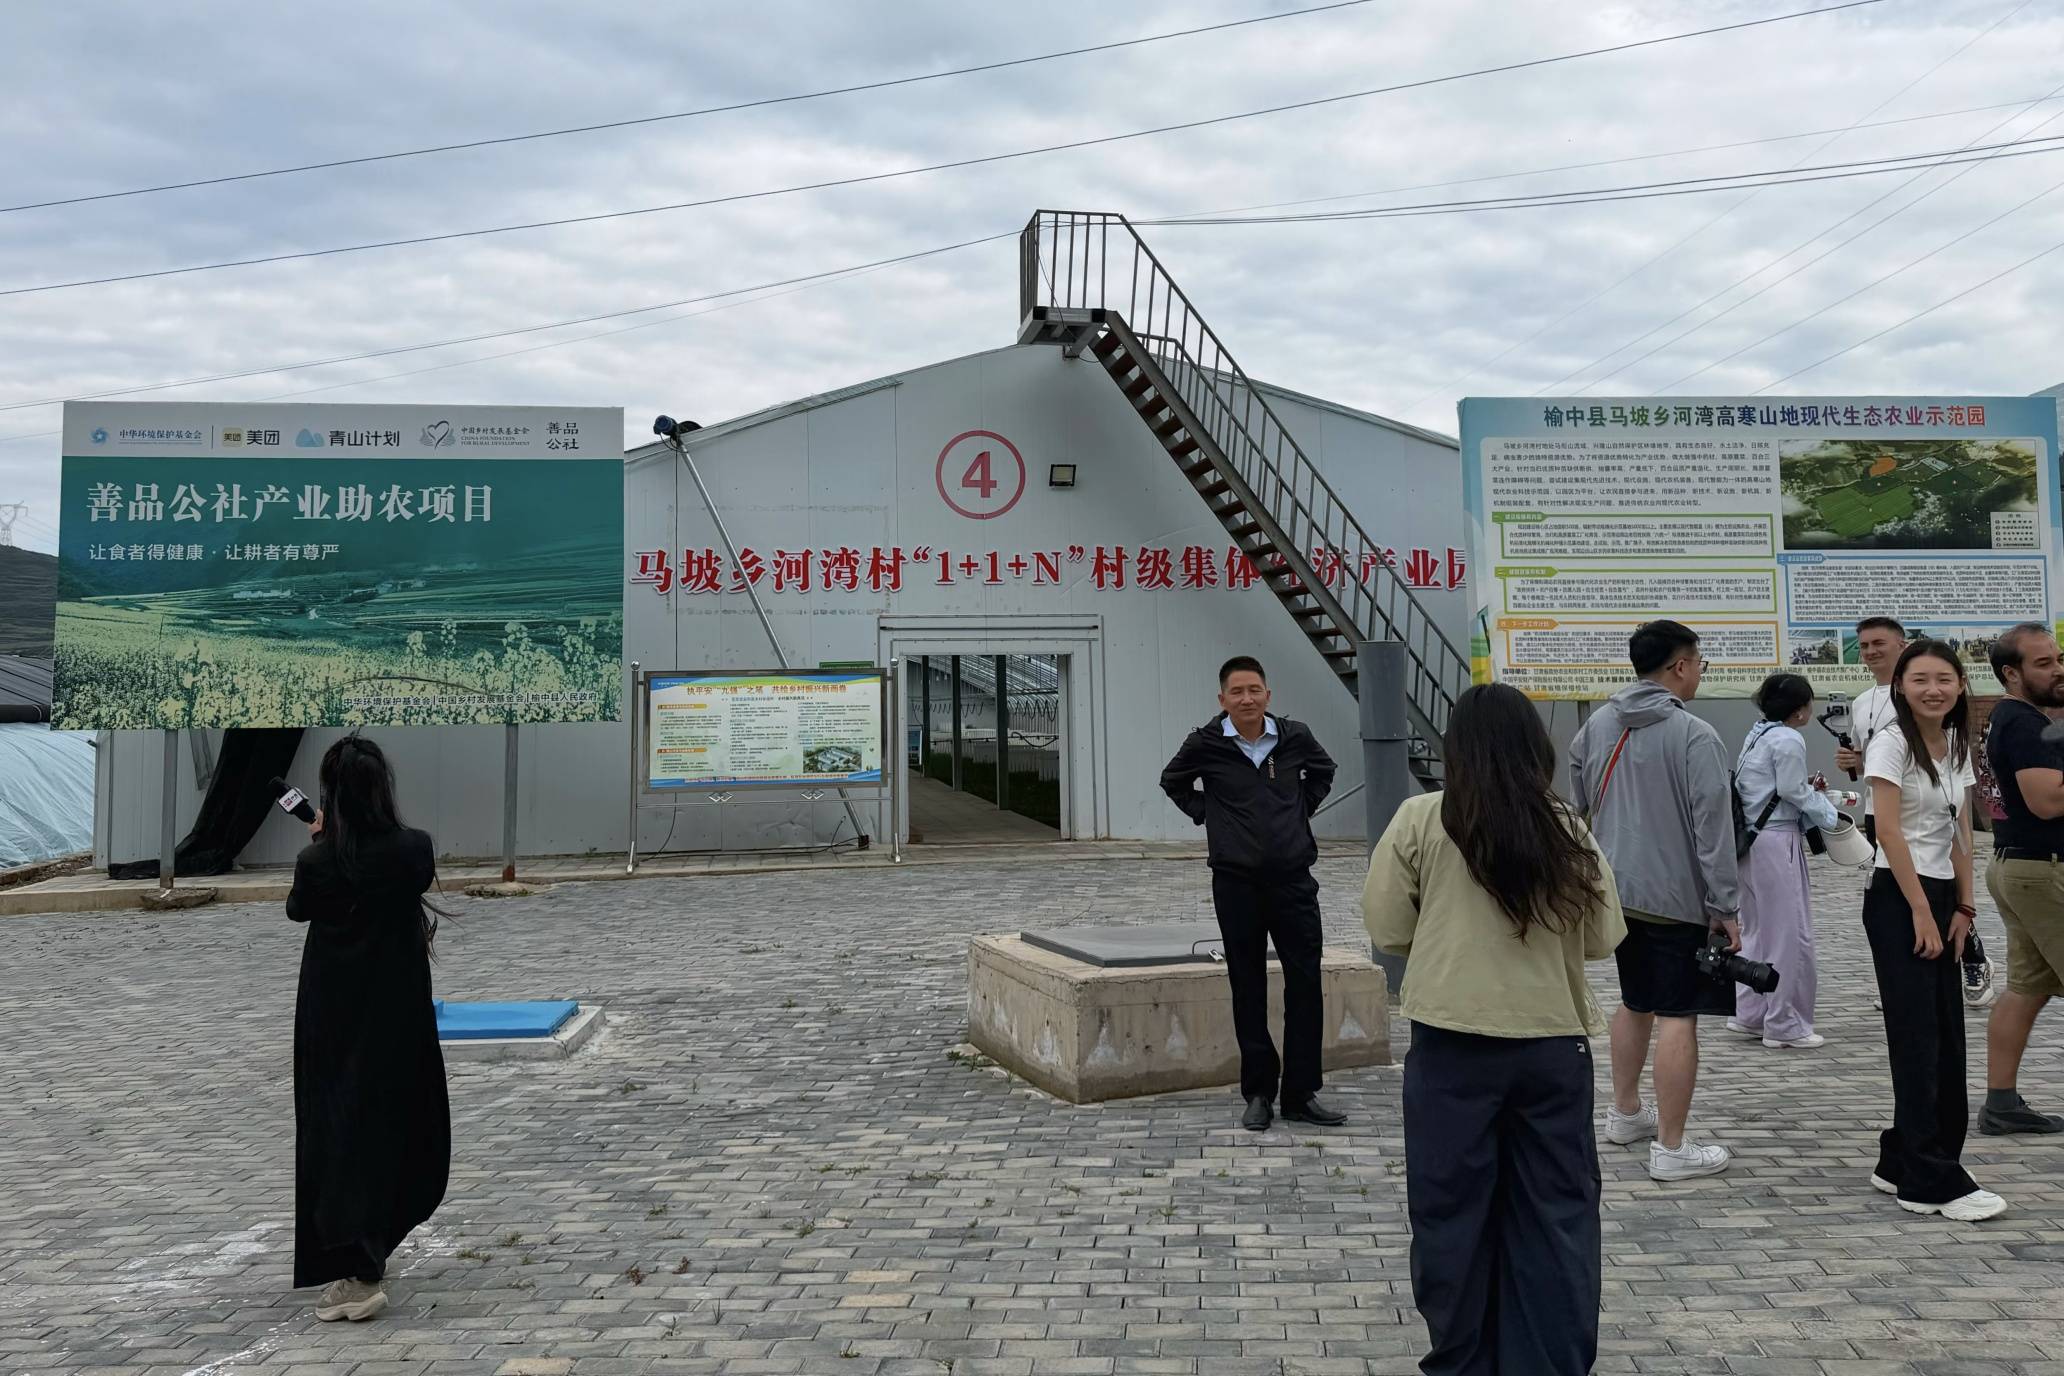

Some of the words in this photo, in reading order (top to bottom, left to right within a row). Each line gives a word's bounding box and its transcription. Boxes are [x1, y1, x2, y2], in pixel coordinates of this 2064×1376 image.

[1543, 404, 1986, 428] 榆中县马坡乡河湾高寒山地现代生态农业示范园
[119, 429, 203, 439] 中华环境保护基金会
[546, 421, 580, 435] 善品
[246, 430, 281, 446] 美团
[328, 430, 401, 447] 青山计划
[546, 437, 580, 451] 公社
[961, 451, 998, 499] 4
[87, 482, 493, 523] 善品公社产业助农项目
